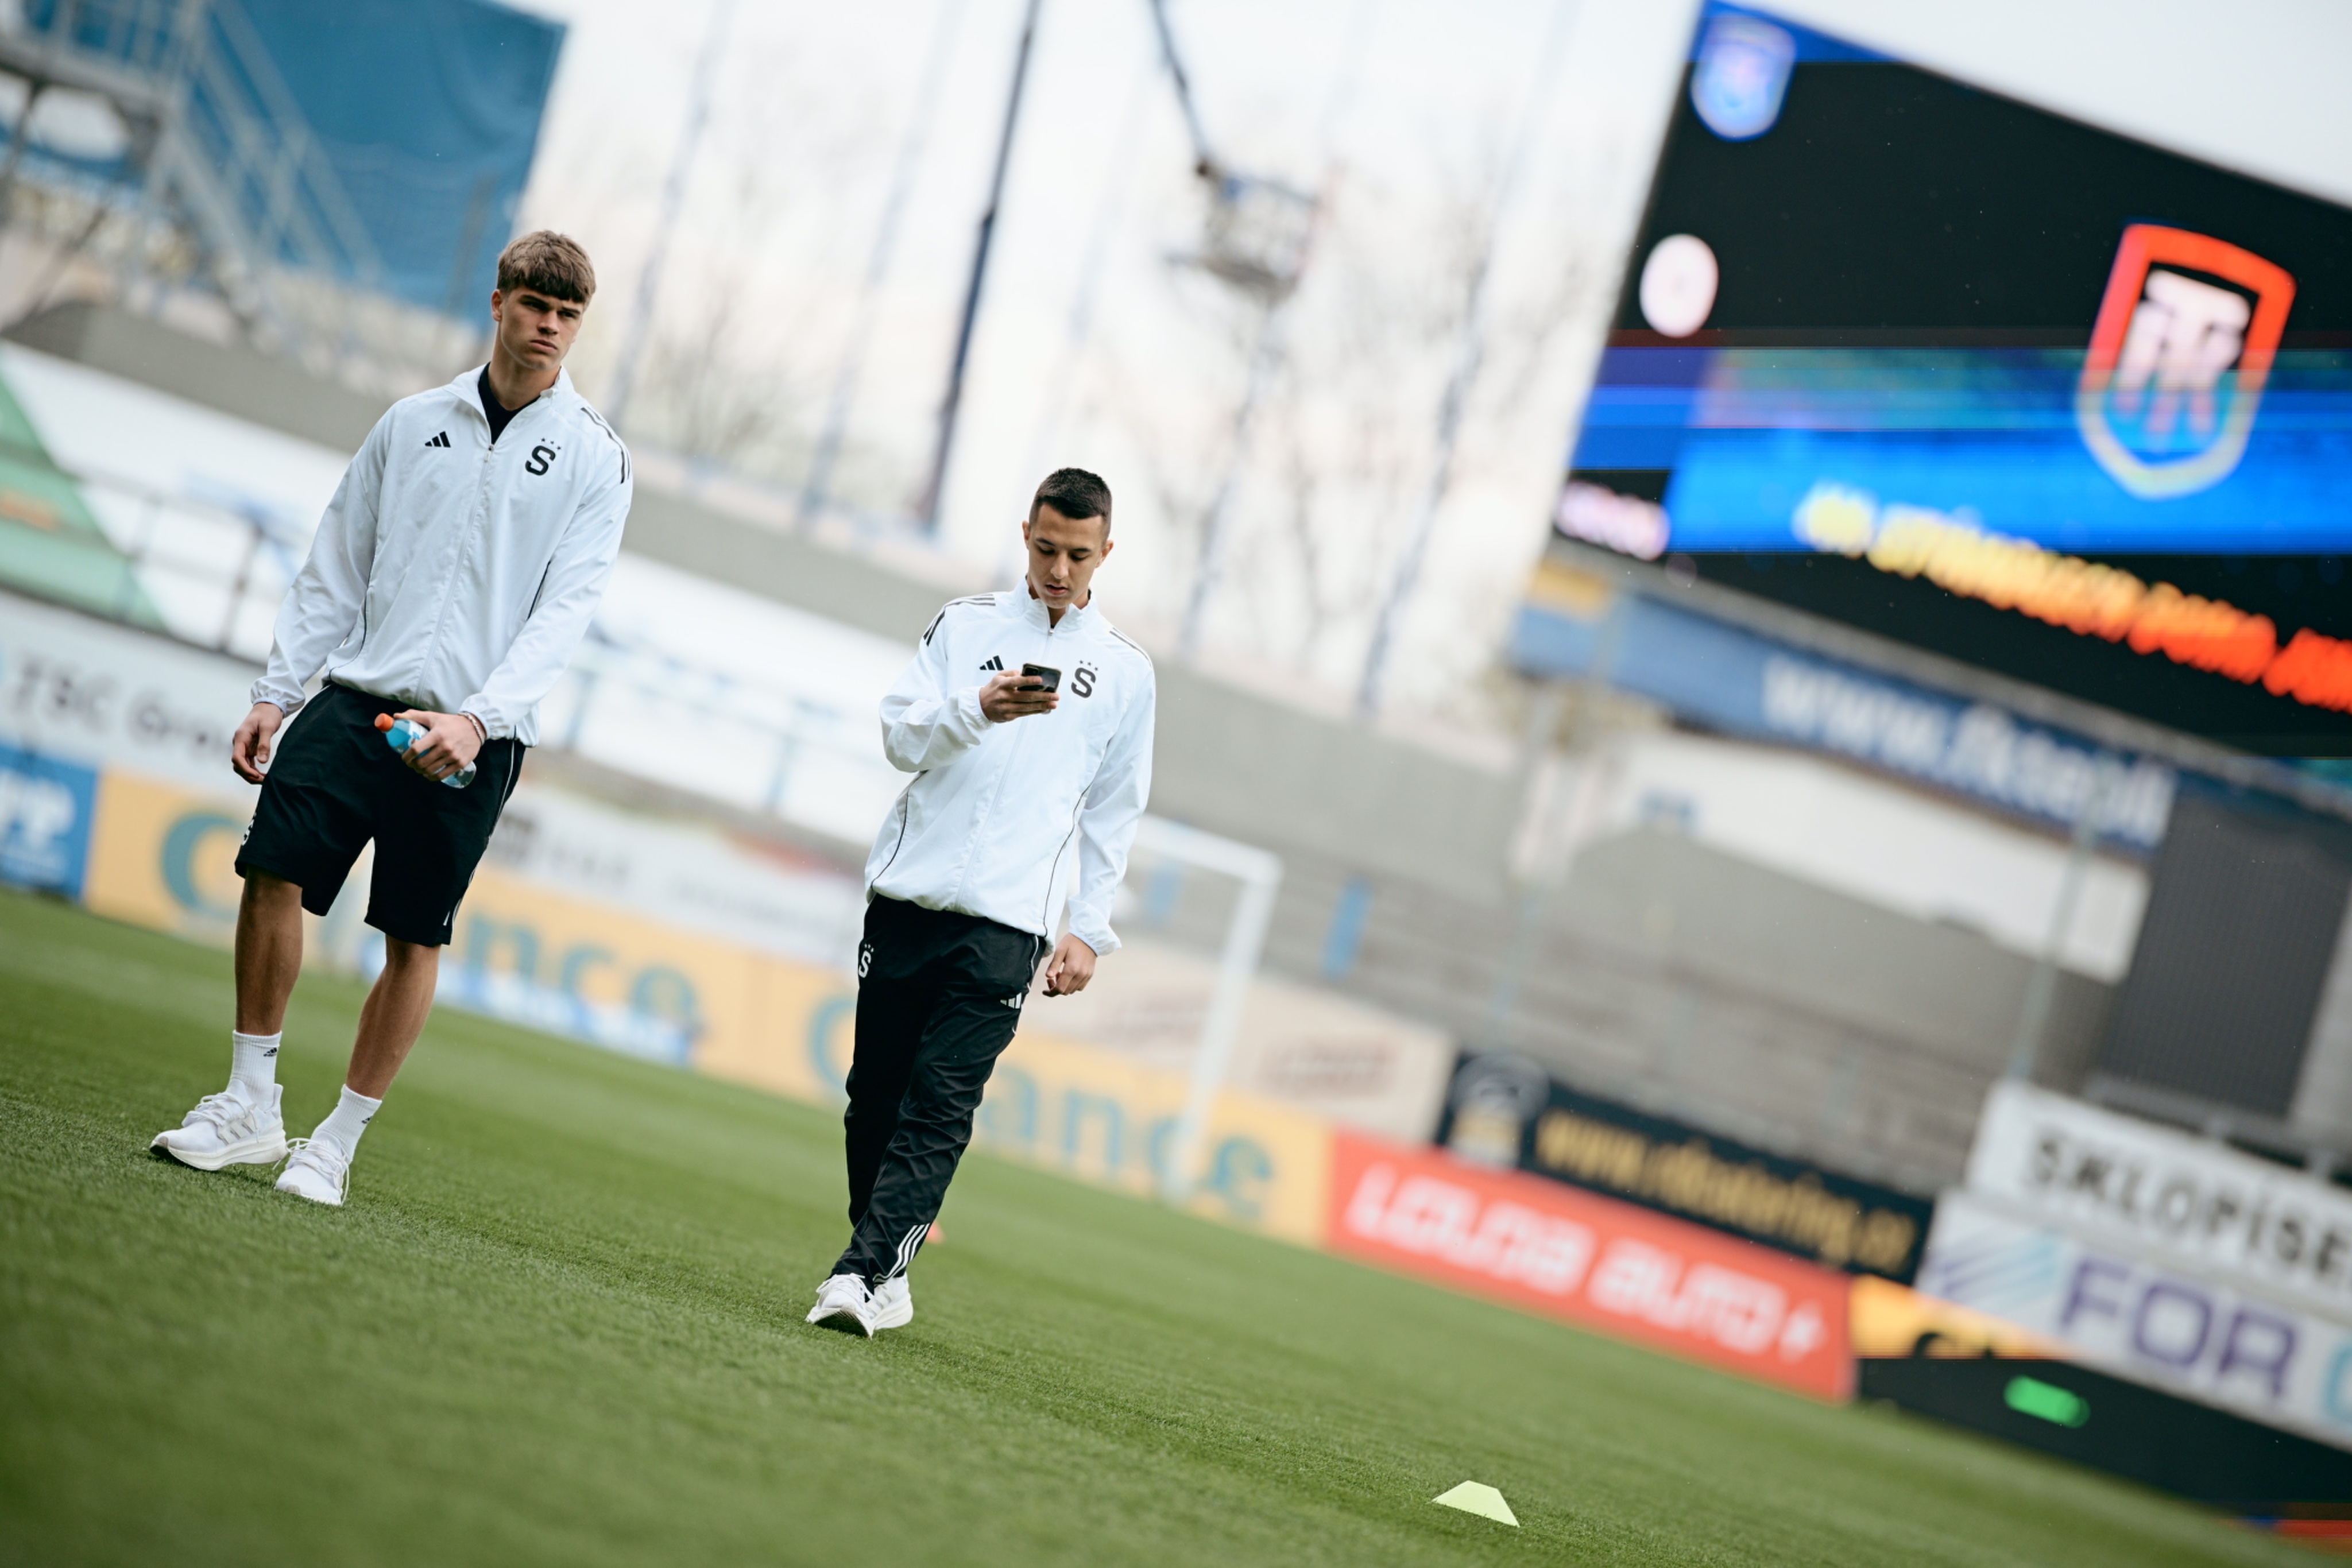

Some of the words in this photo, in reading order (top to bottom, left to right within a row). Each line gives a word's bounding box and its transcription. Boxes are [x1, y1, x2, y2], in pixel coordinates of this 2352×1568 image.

[525, 445, 556, 476] S
[1071, 667, 1096, 699] S
[858, 950, 872, 978] S
[2058, 1253, 2300, 1400] FOR
